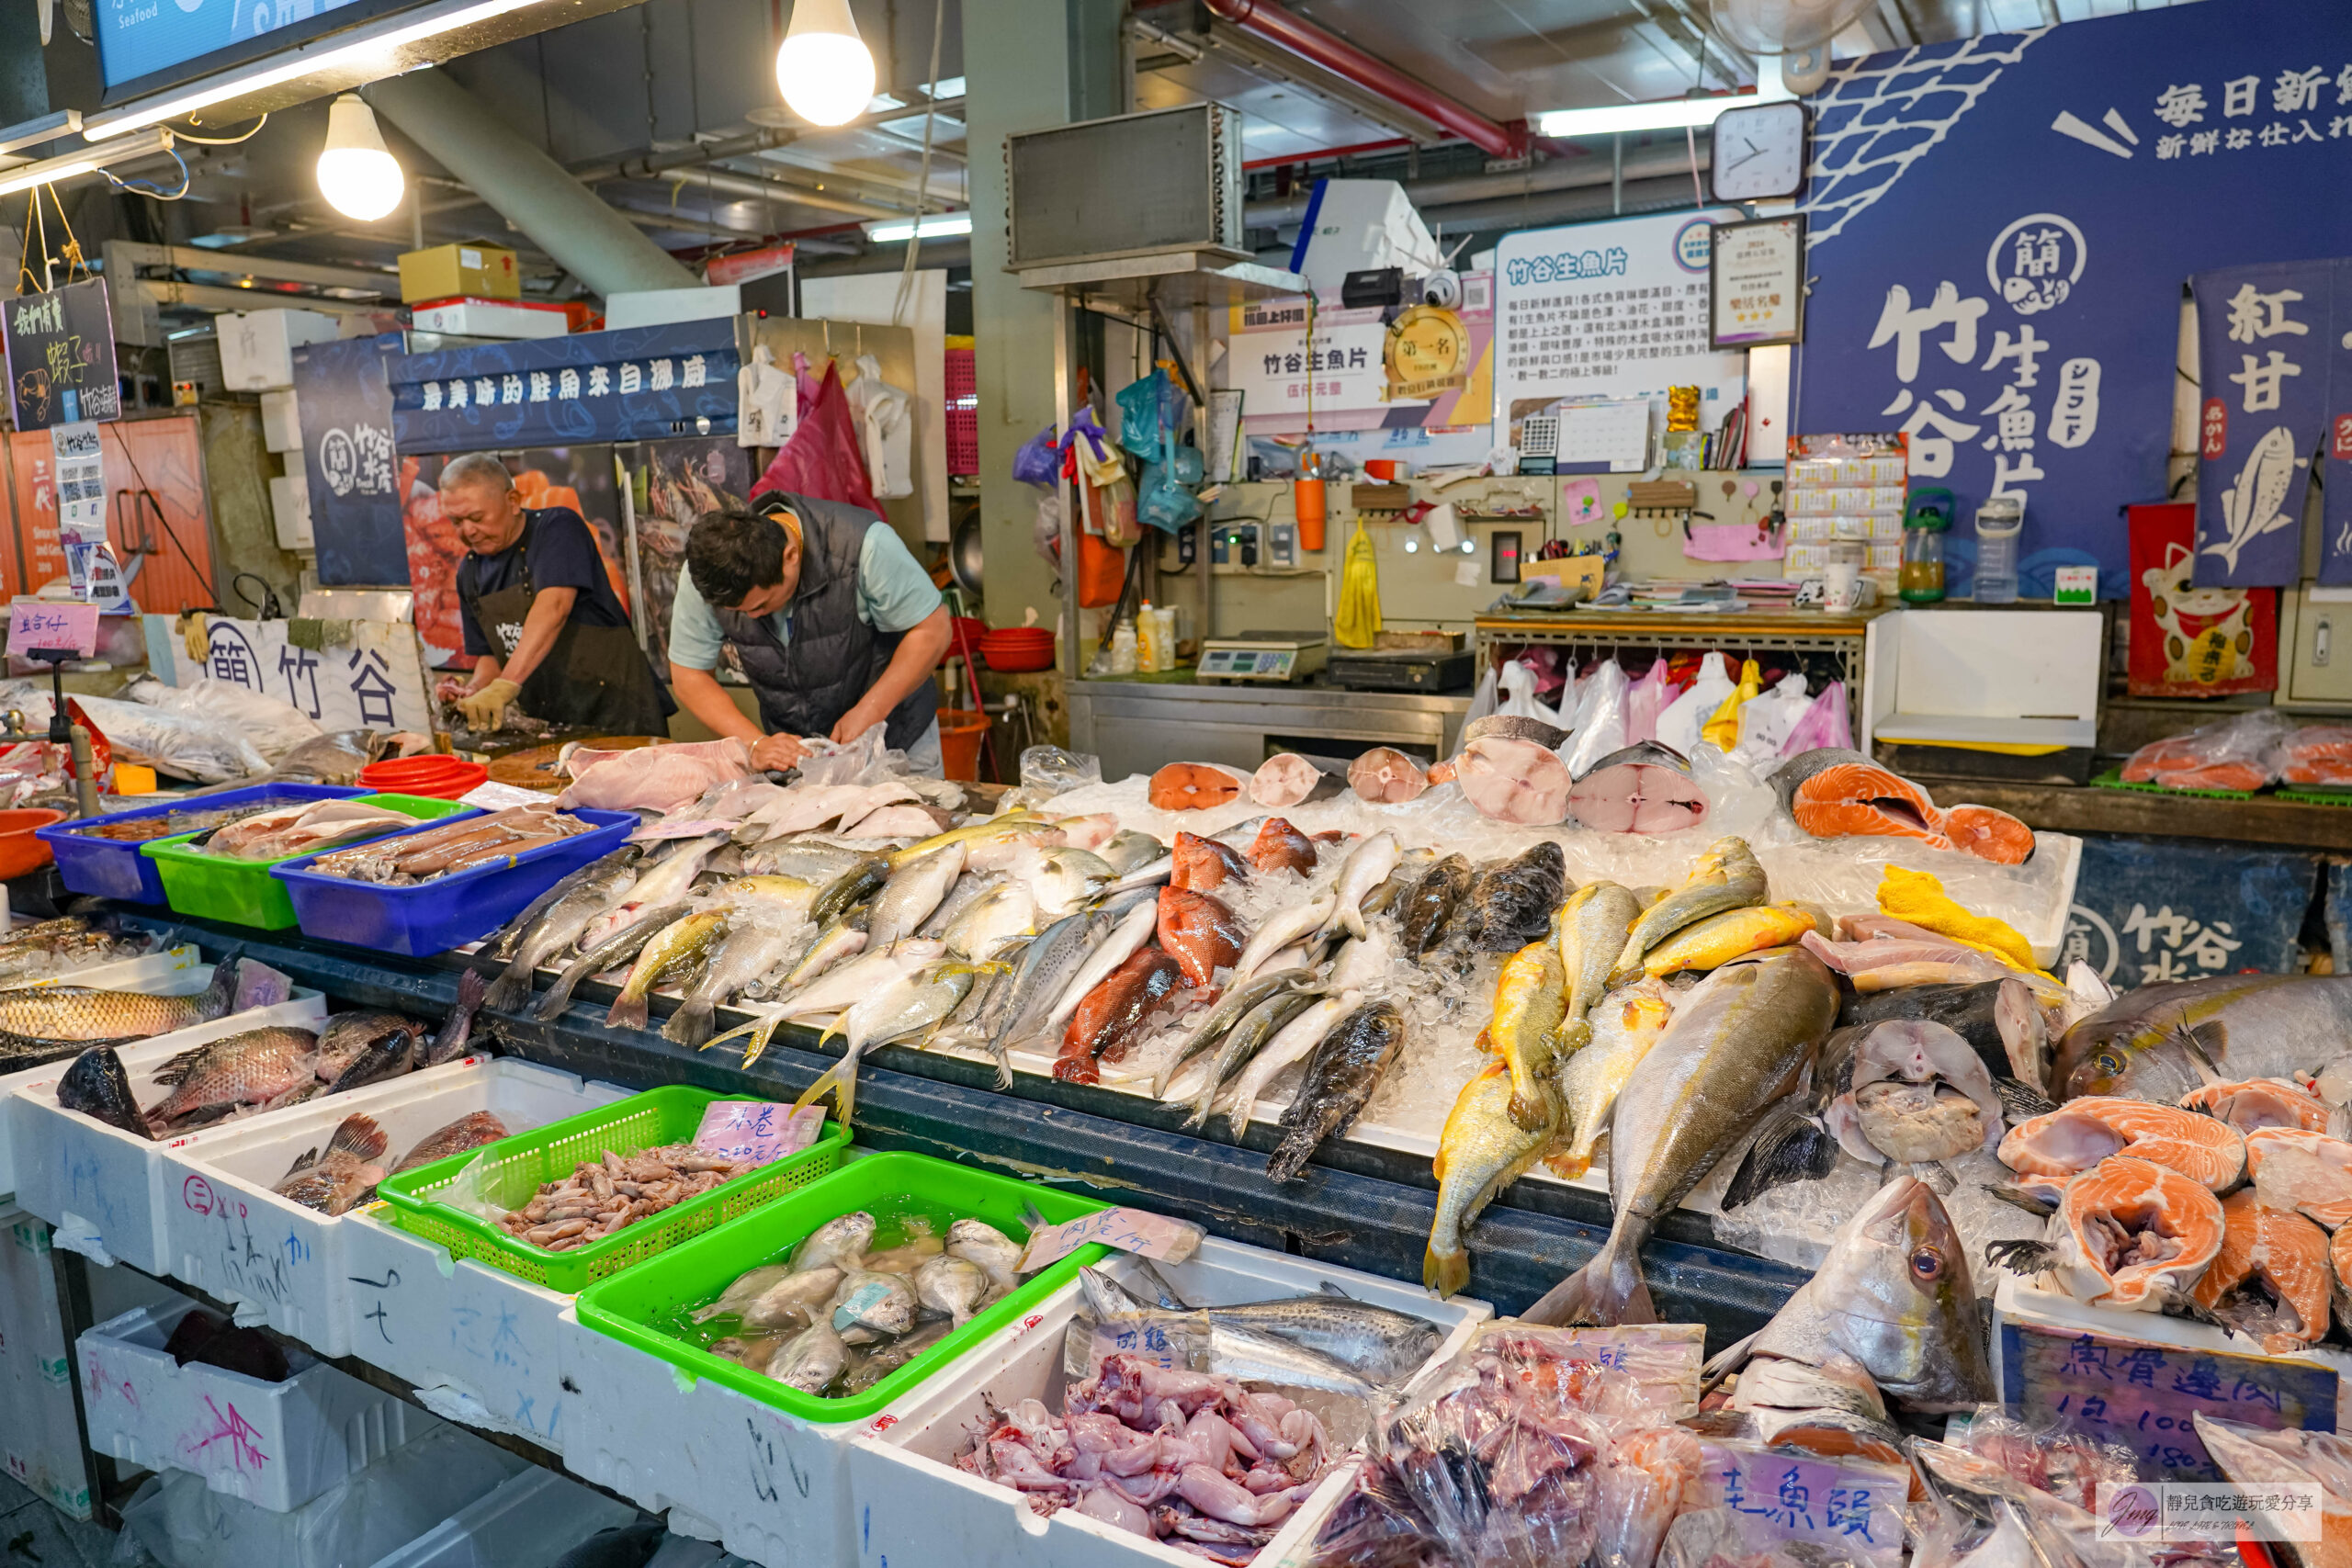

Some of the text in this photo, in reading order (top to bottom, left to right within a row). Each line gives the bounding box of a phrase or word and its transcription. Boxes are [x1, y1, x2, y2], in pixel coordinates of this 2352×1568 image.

[119, 5, 158, 29] Seafood
[1507, 247, 1628, 286] 竹谷生魚片
[2015, 229, 2064, 276] 簡
[14, 296, 63, 336] 我們有賣
[47, 335, 87, 383] 蝦子
[1263, 347, 1368, 375] 竹谷生魚片
[1403, 337, 1450, 357] 第一名
[2227, 283, 2309, 413] 紅甘
[422, 355, 707, 412] 最美味的鮭魚來自挪威
[1868, 280, 1990, 478] 竹谷
[1980, 324, 2050, 511] 生魚片
[278, 645, 396, 728] 竹谷
[2121, 902, 2243, 970] 竹谷
[725, 1104, 774, 1137] 小卷
